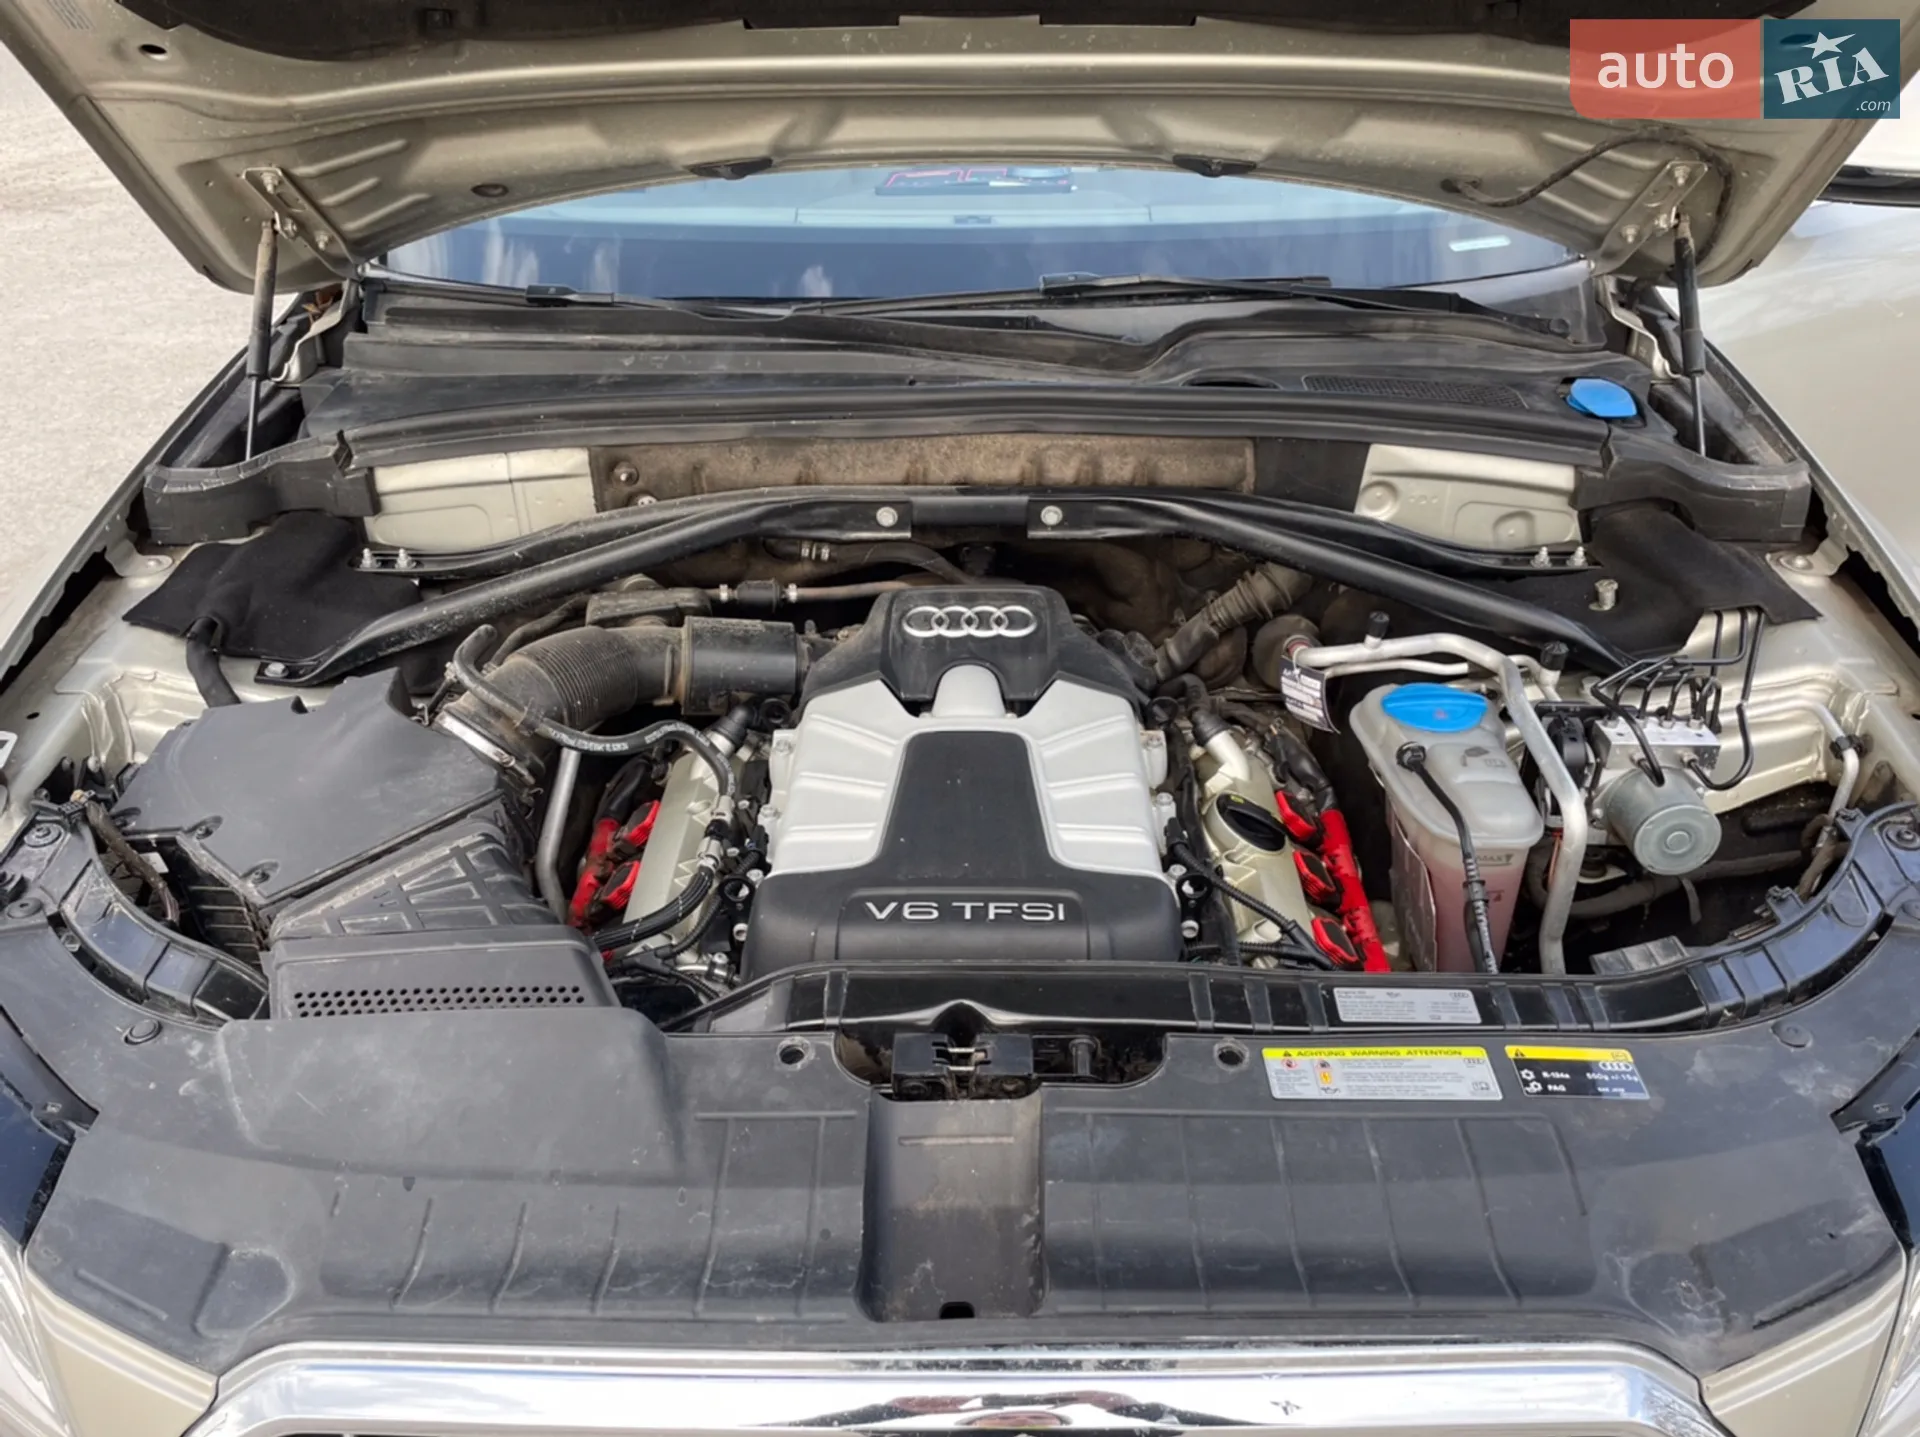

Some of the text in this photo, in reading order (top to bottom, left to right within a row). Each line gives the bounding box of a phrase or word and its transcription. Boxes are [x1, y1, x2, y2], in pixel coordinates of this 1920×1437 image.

[865, 902, 1066, 921] V6 TFSI
[1296, 1050, 1345, 1058] ACHTUNG
[1406, 1049, 1462, 1057] ATTENTION
